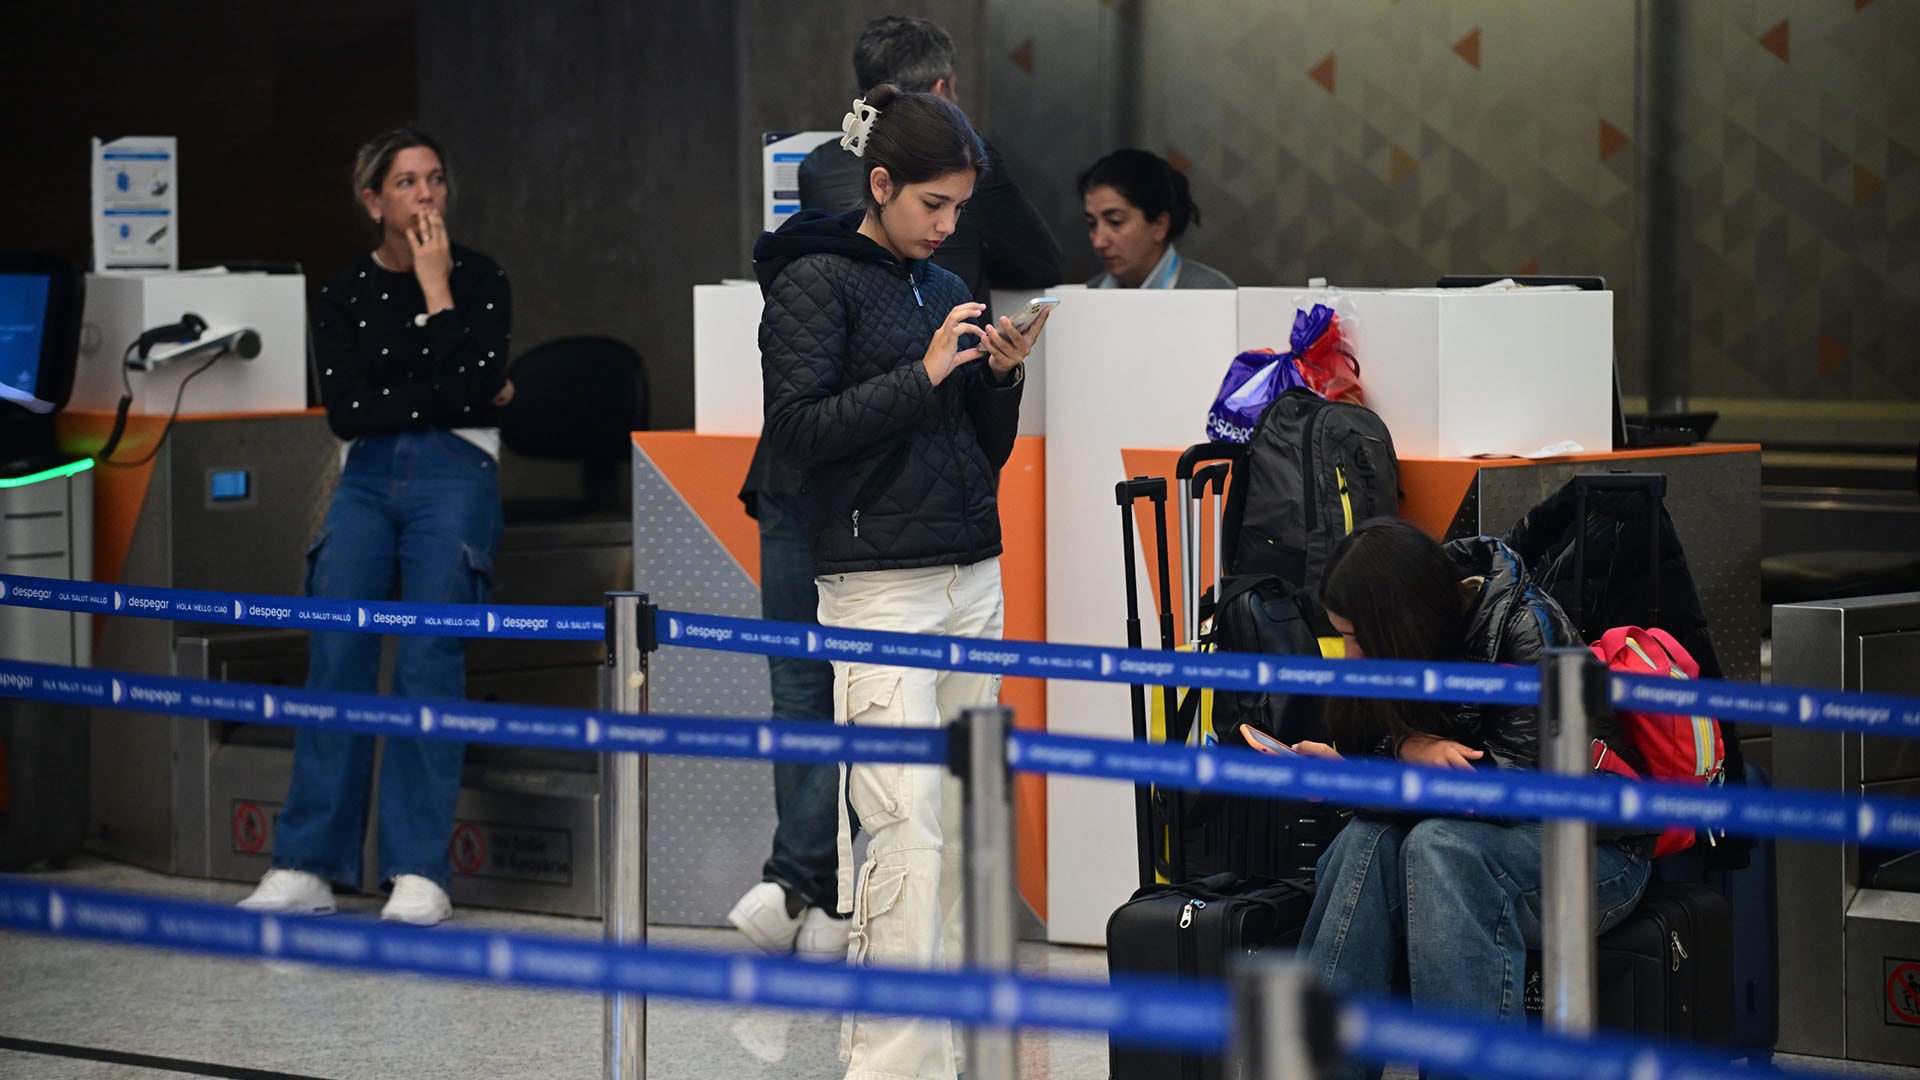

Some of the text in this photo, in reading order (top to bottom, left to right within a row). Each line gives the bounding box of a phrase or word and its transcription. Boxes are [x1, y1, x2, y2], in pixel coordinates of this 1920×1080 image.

[13, 587, 52, 600] despegar
[128, 597, 168, 611] despegar
[249, 605, 291, 619] despegar
[312, 612, 330, 620] SALUT
[373, 613, 416, 626] despegar
[425, 617, 442, 625] HOLA
[443, 618, 463, 626] HELLO
[503, 617, 548, 631] despegar
[686, 624, 732, 641] despegar
[824, 637, 873, 654] despegar
[968, 650, 1019, 665] despegar
[1120, 660, 1174, 676] despegar
[130, 687, 181, 705] despegar
